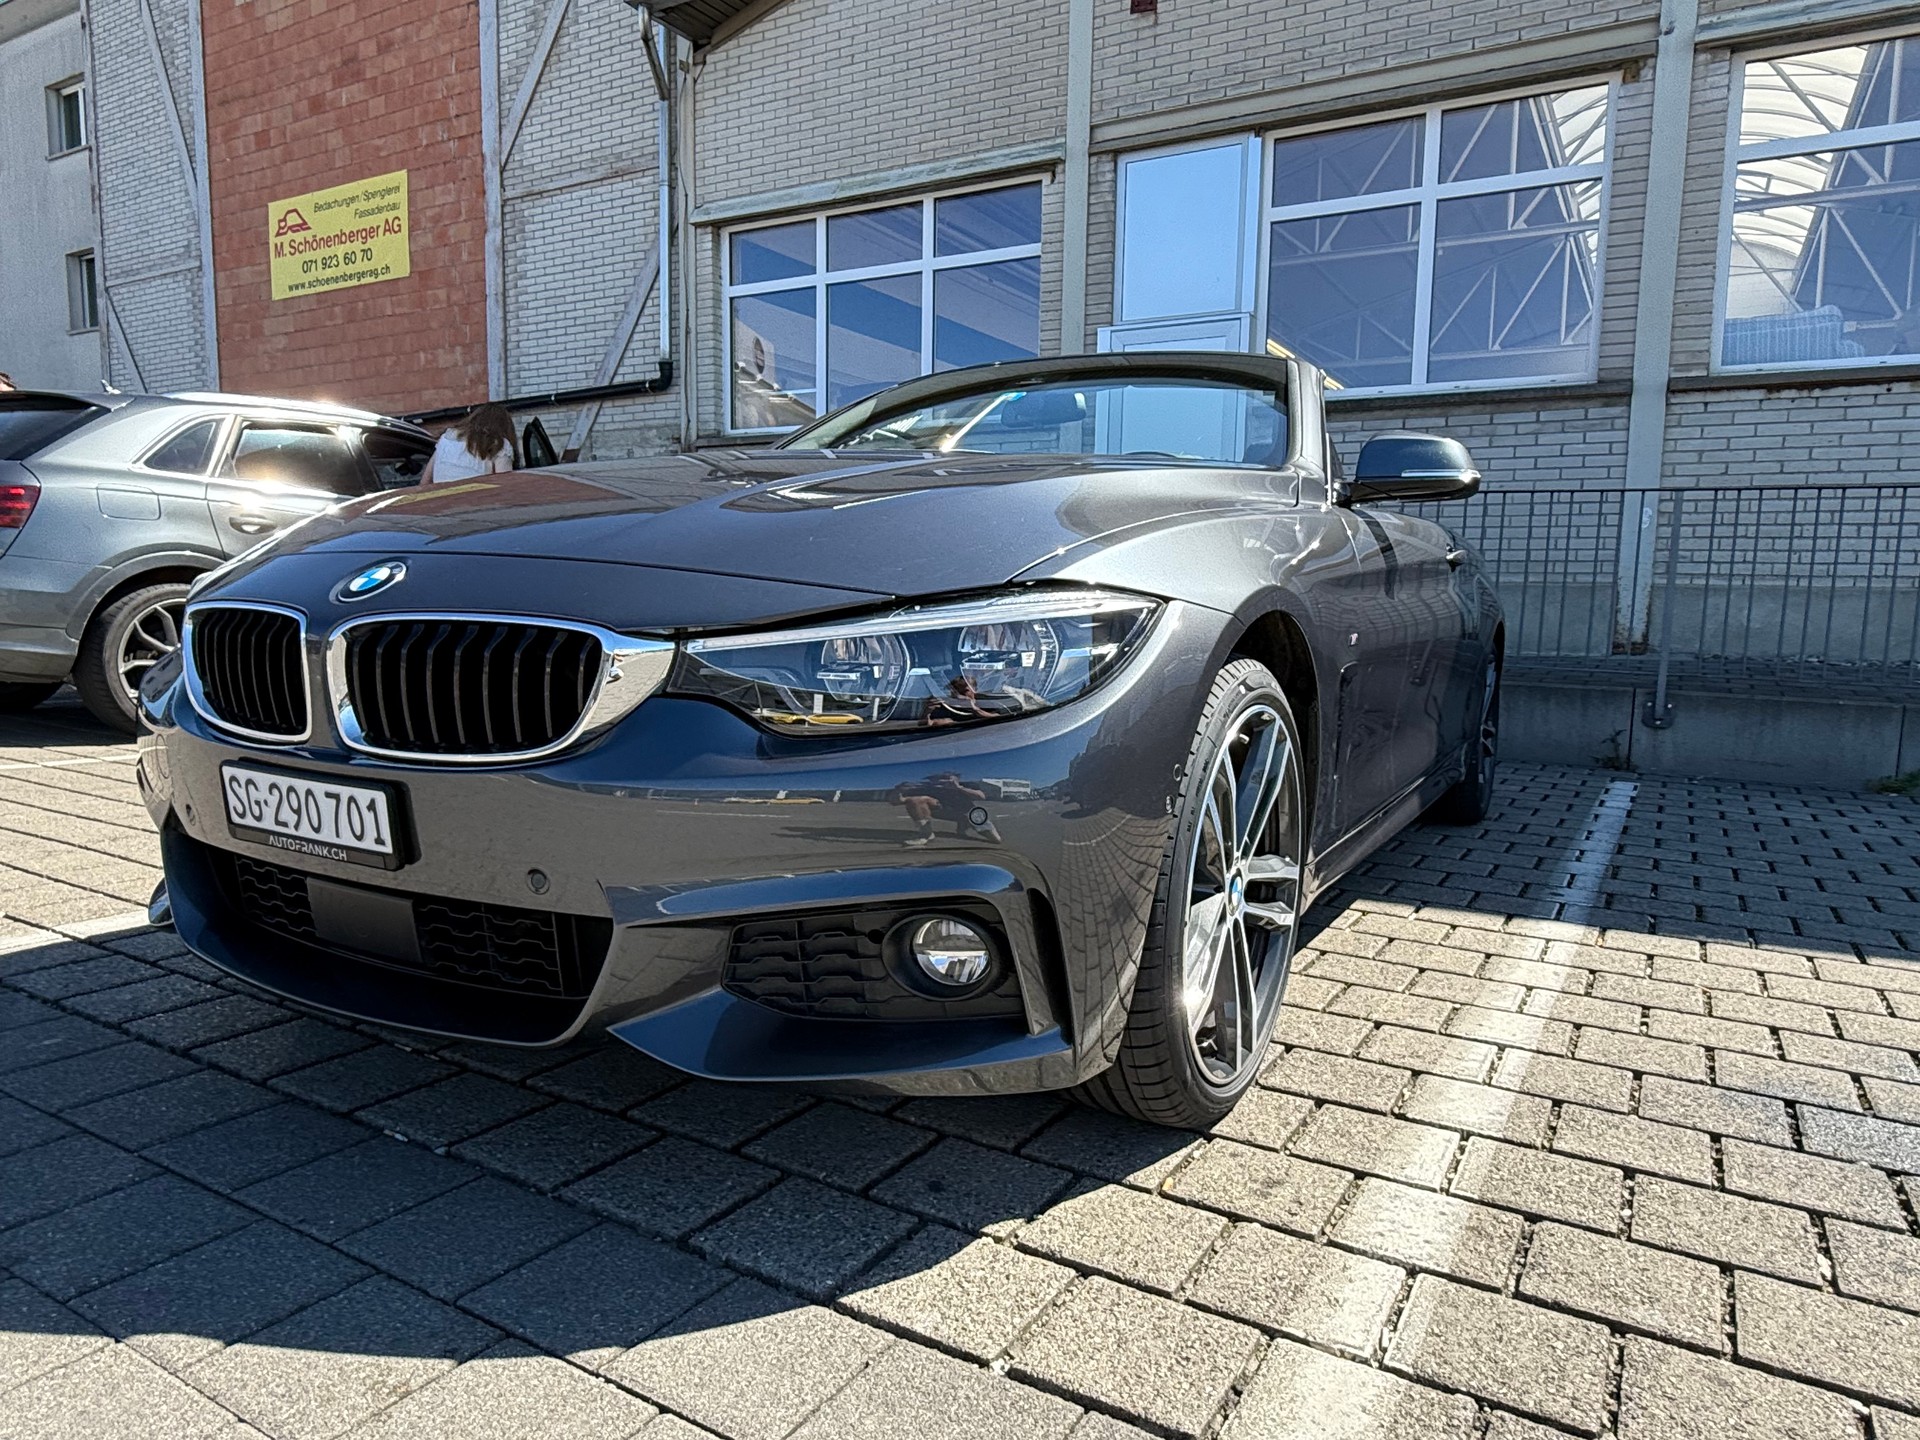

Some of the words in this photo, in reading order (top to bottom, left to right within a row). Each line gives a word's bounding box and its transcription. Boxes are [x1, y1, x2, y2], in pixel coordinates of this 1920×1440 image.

[313, 185, 400, 213] Bedachungen/Spenglerei
[354, 203, 401, 219] Fassadenbau
[274, 241, 287, 259] M.
[288, 224, 381, 256] Schönenberger
[383, 216, 402, 236] AG
[302, 259, 318, 274] 071
[321, 254, 340, 270] 923
[343, 250, 357, 265] 60
[360, 247, 373, 261] 70
[288, 263, 391, 292] www.schoenenbergerag.ch
[268, 834, 347, 861] AUTOFRANK.CH
